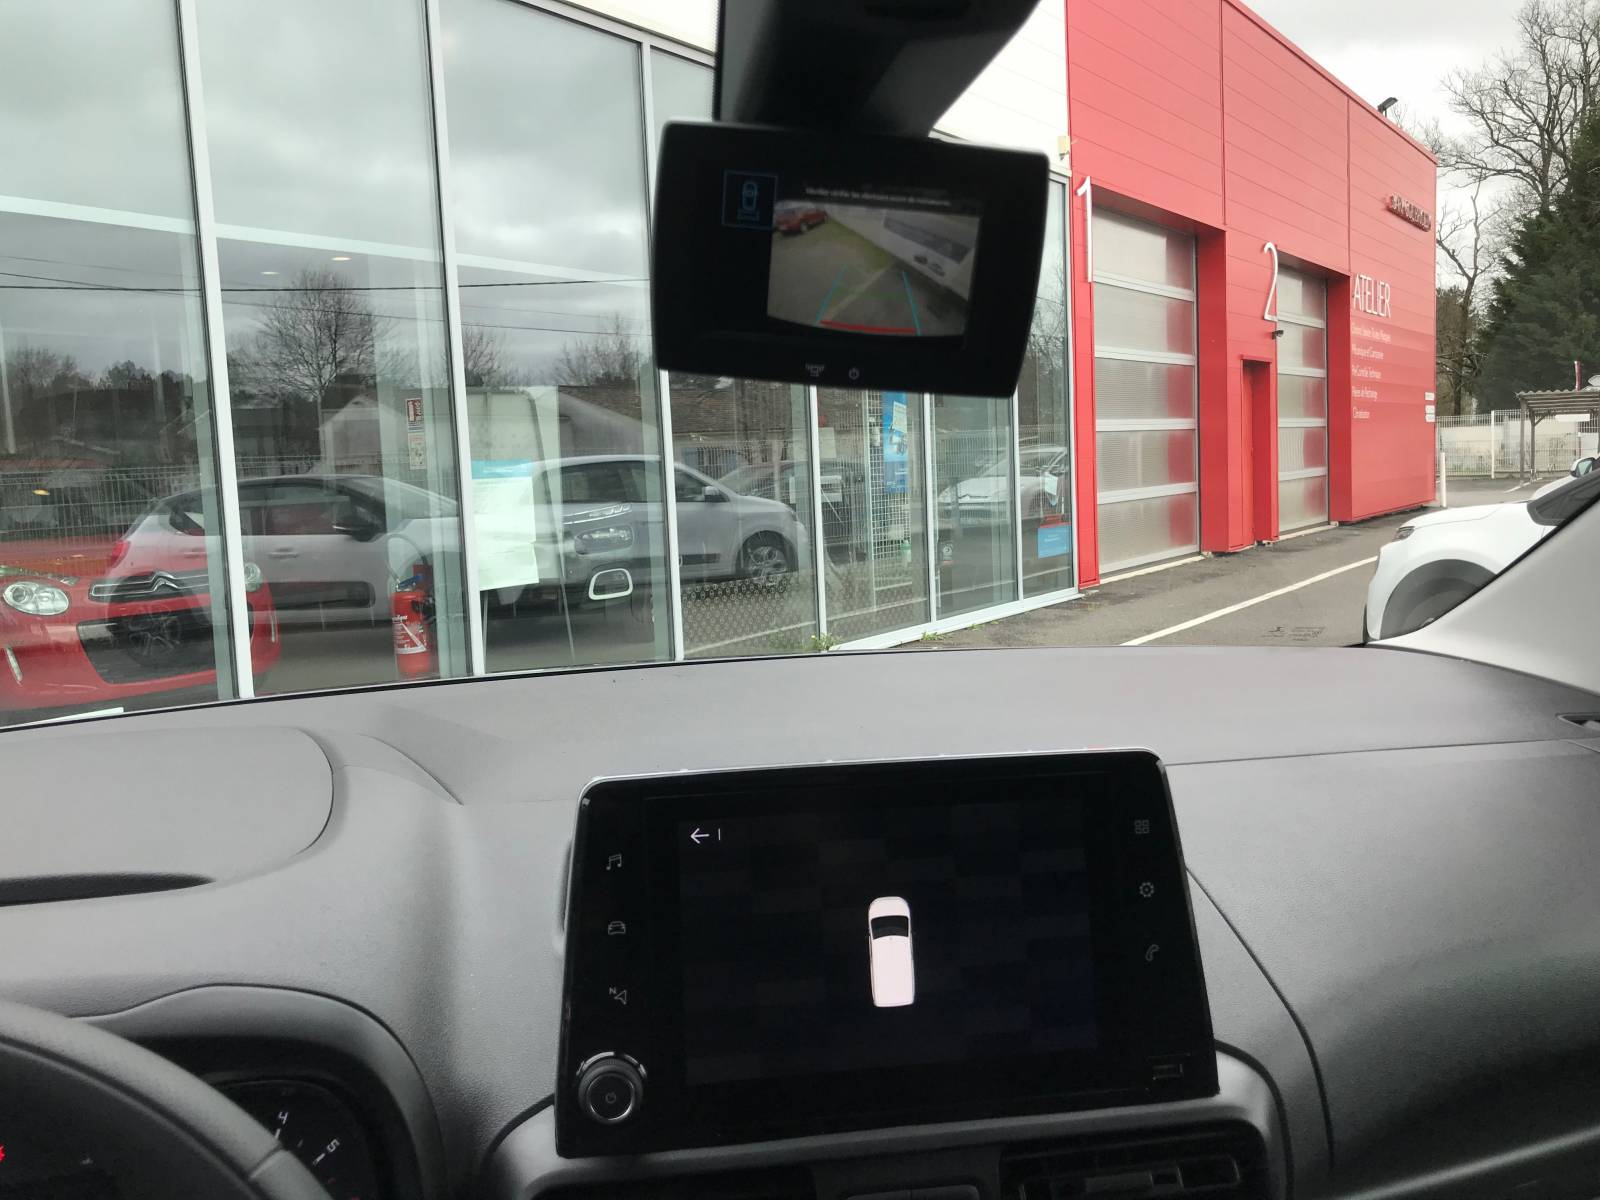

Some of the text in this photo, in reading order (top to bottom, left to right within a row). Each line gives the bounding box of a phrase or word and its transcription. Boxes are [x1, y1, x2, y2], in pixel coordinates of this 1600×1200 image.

[1076, 175, 1092, 283] 1
[1263, 241, 1279, 322] 2
[1353, 273, 1391, 319] ATELIER
[278, 1111, 289, 1125] 4
[326, 1138, 340, 1153] 5
